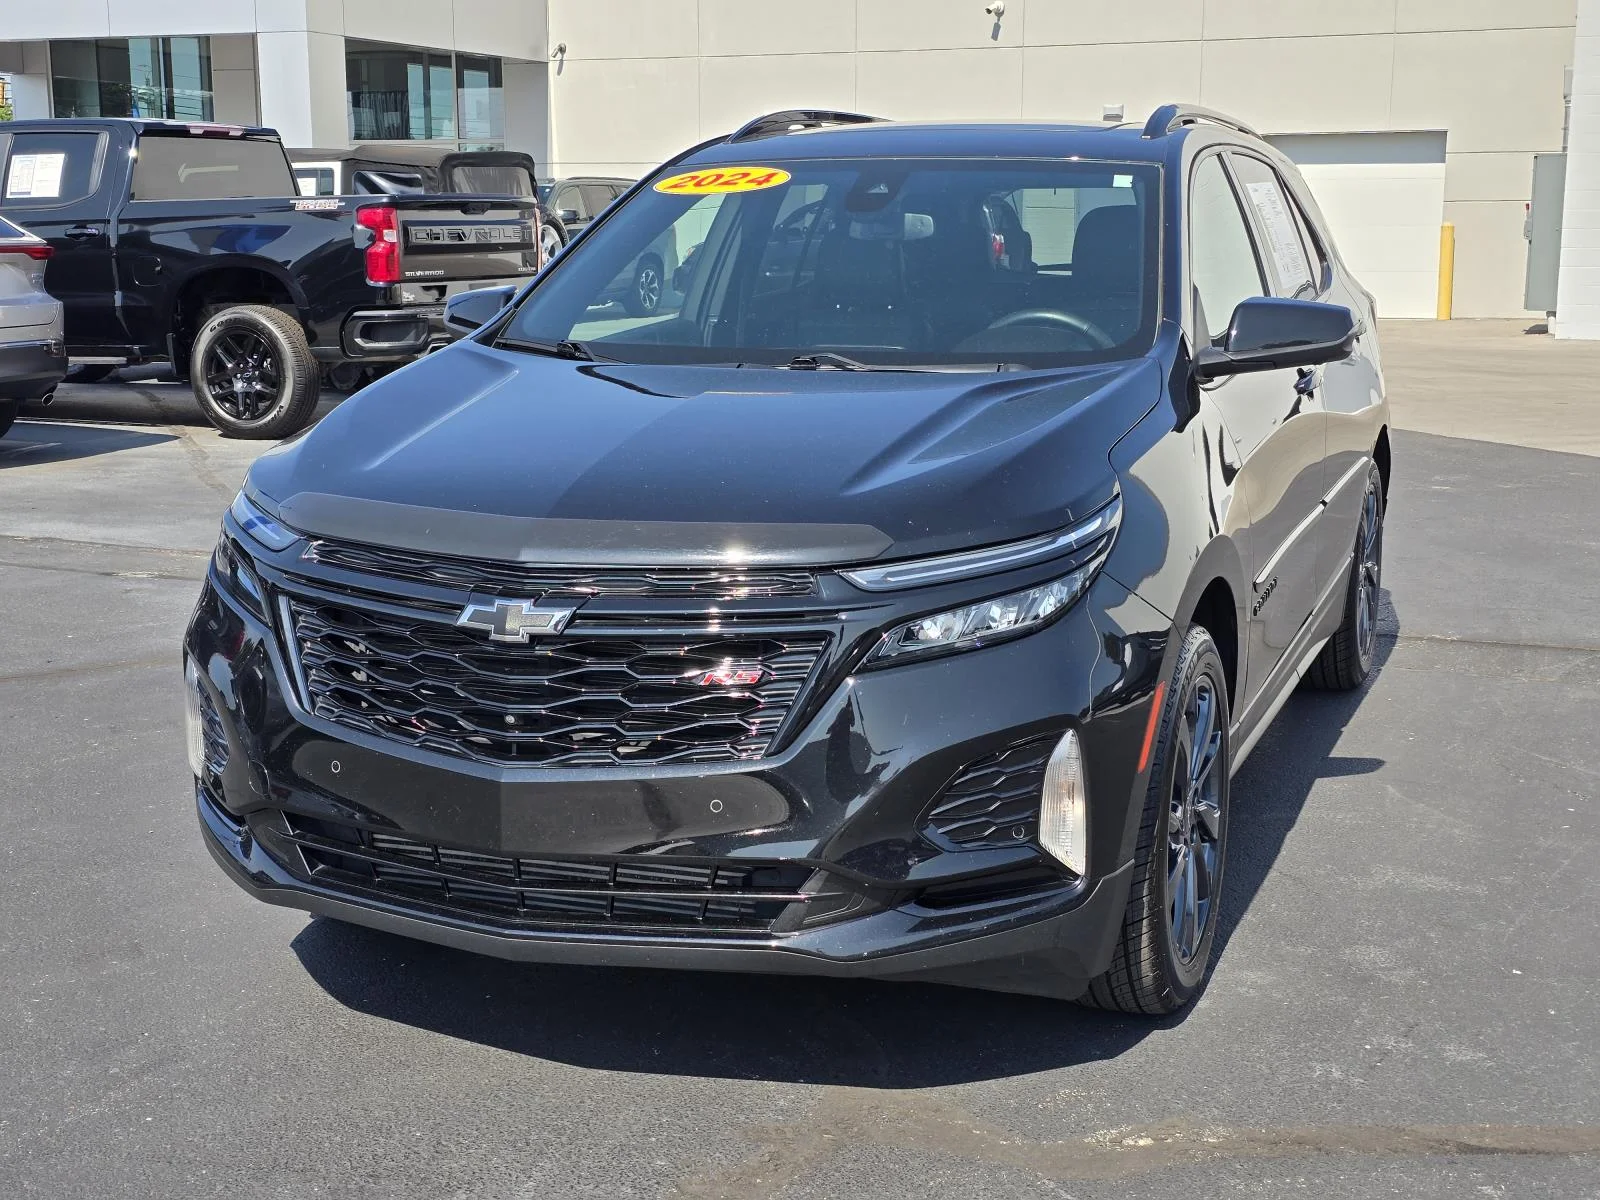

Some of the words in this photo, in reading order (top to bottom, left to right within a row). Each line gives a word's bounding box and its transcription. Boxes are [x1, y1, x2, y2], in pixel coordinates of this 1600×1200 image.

[663, 172, 779, 190] 2024
[411, 228, 531, 242] CHEVROLET
[698, 669, 763, 686] RS
